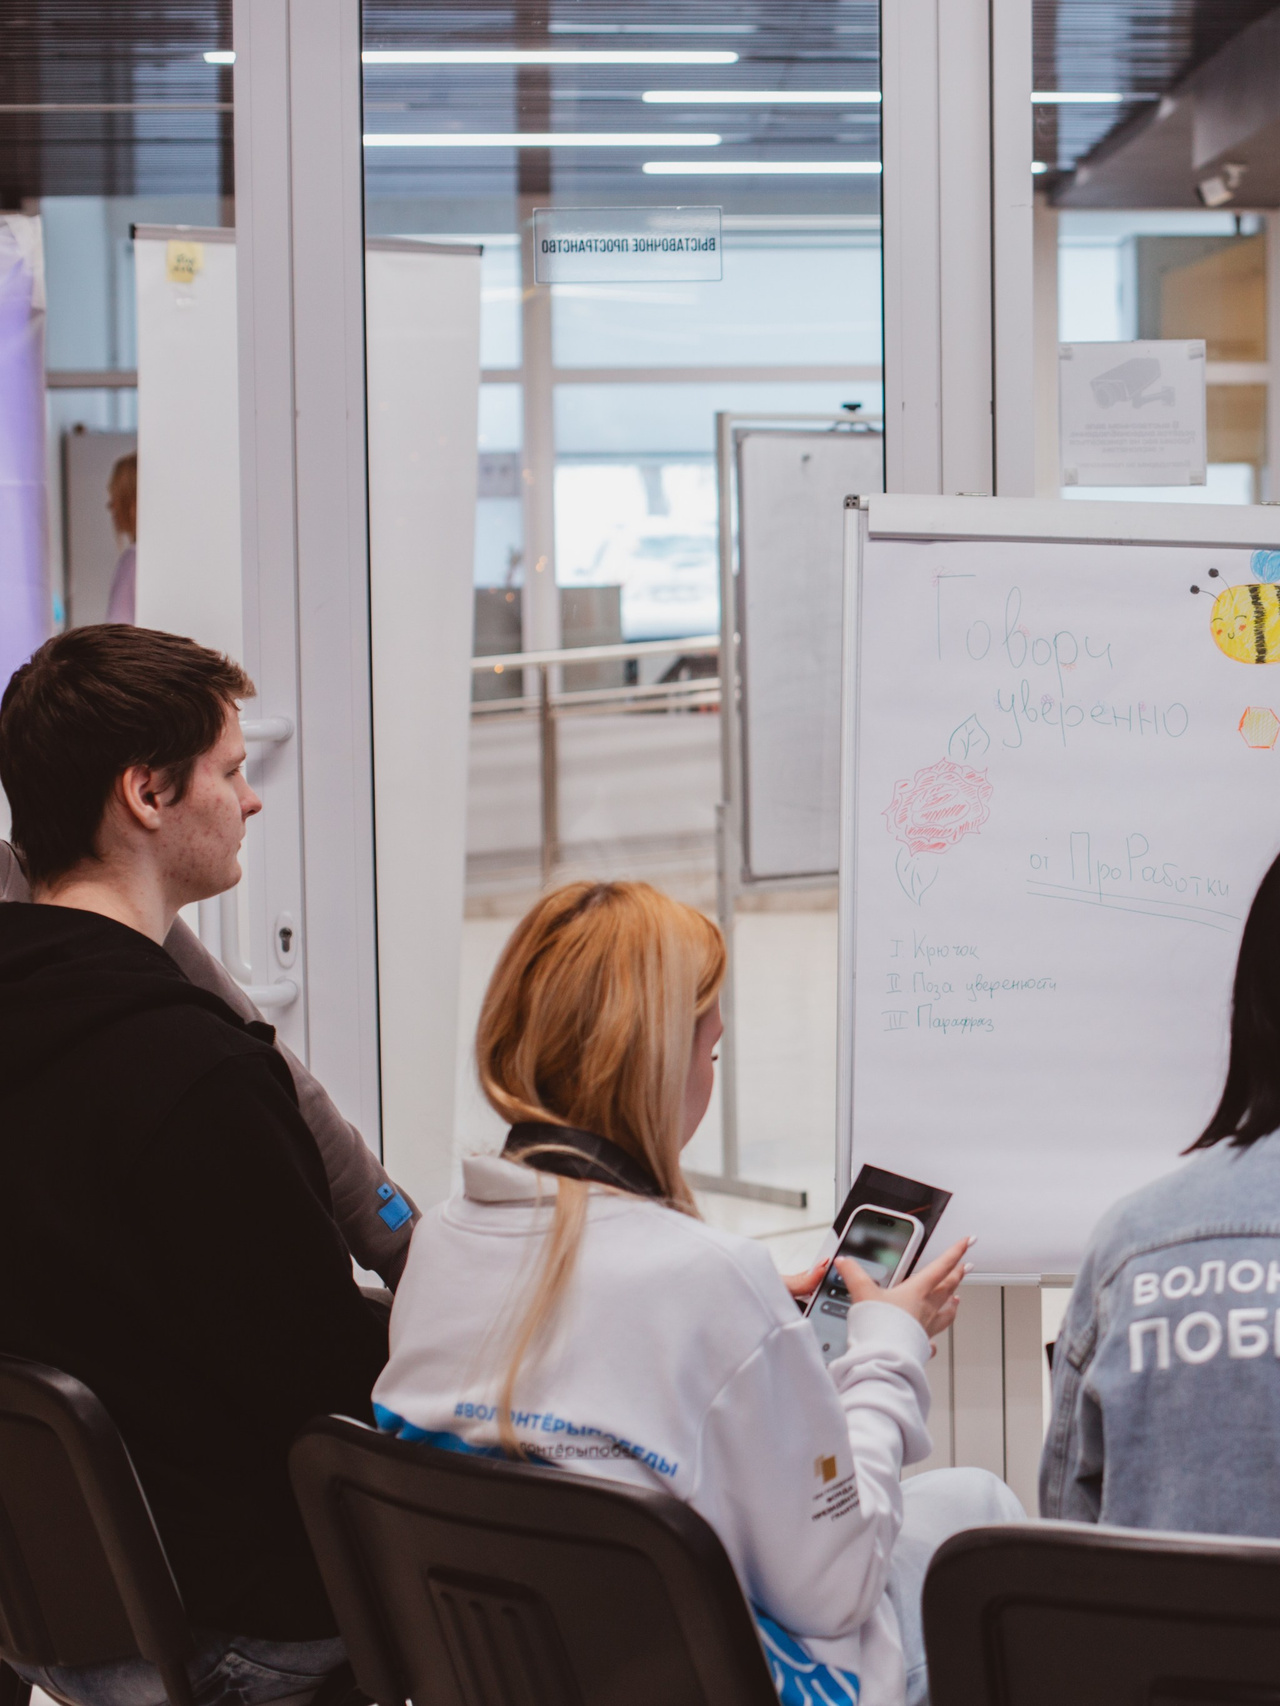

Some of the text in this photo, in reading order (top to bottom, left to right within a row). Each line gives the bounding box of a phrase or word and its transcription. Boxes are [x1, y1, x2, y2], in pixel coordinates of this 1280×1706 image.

[937, 574, 1113, 699] Говори
[997, 679, 1189, 749] уверенно
[1029, 853, 1049, 871] от
[912, 928, 981, 967] Крючок
[912, 971, 955, 1001] Поза
[965, 973, 1058, 1003] уверенности
[916, 1003, 995, 1035] Парафраз
